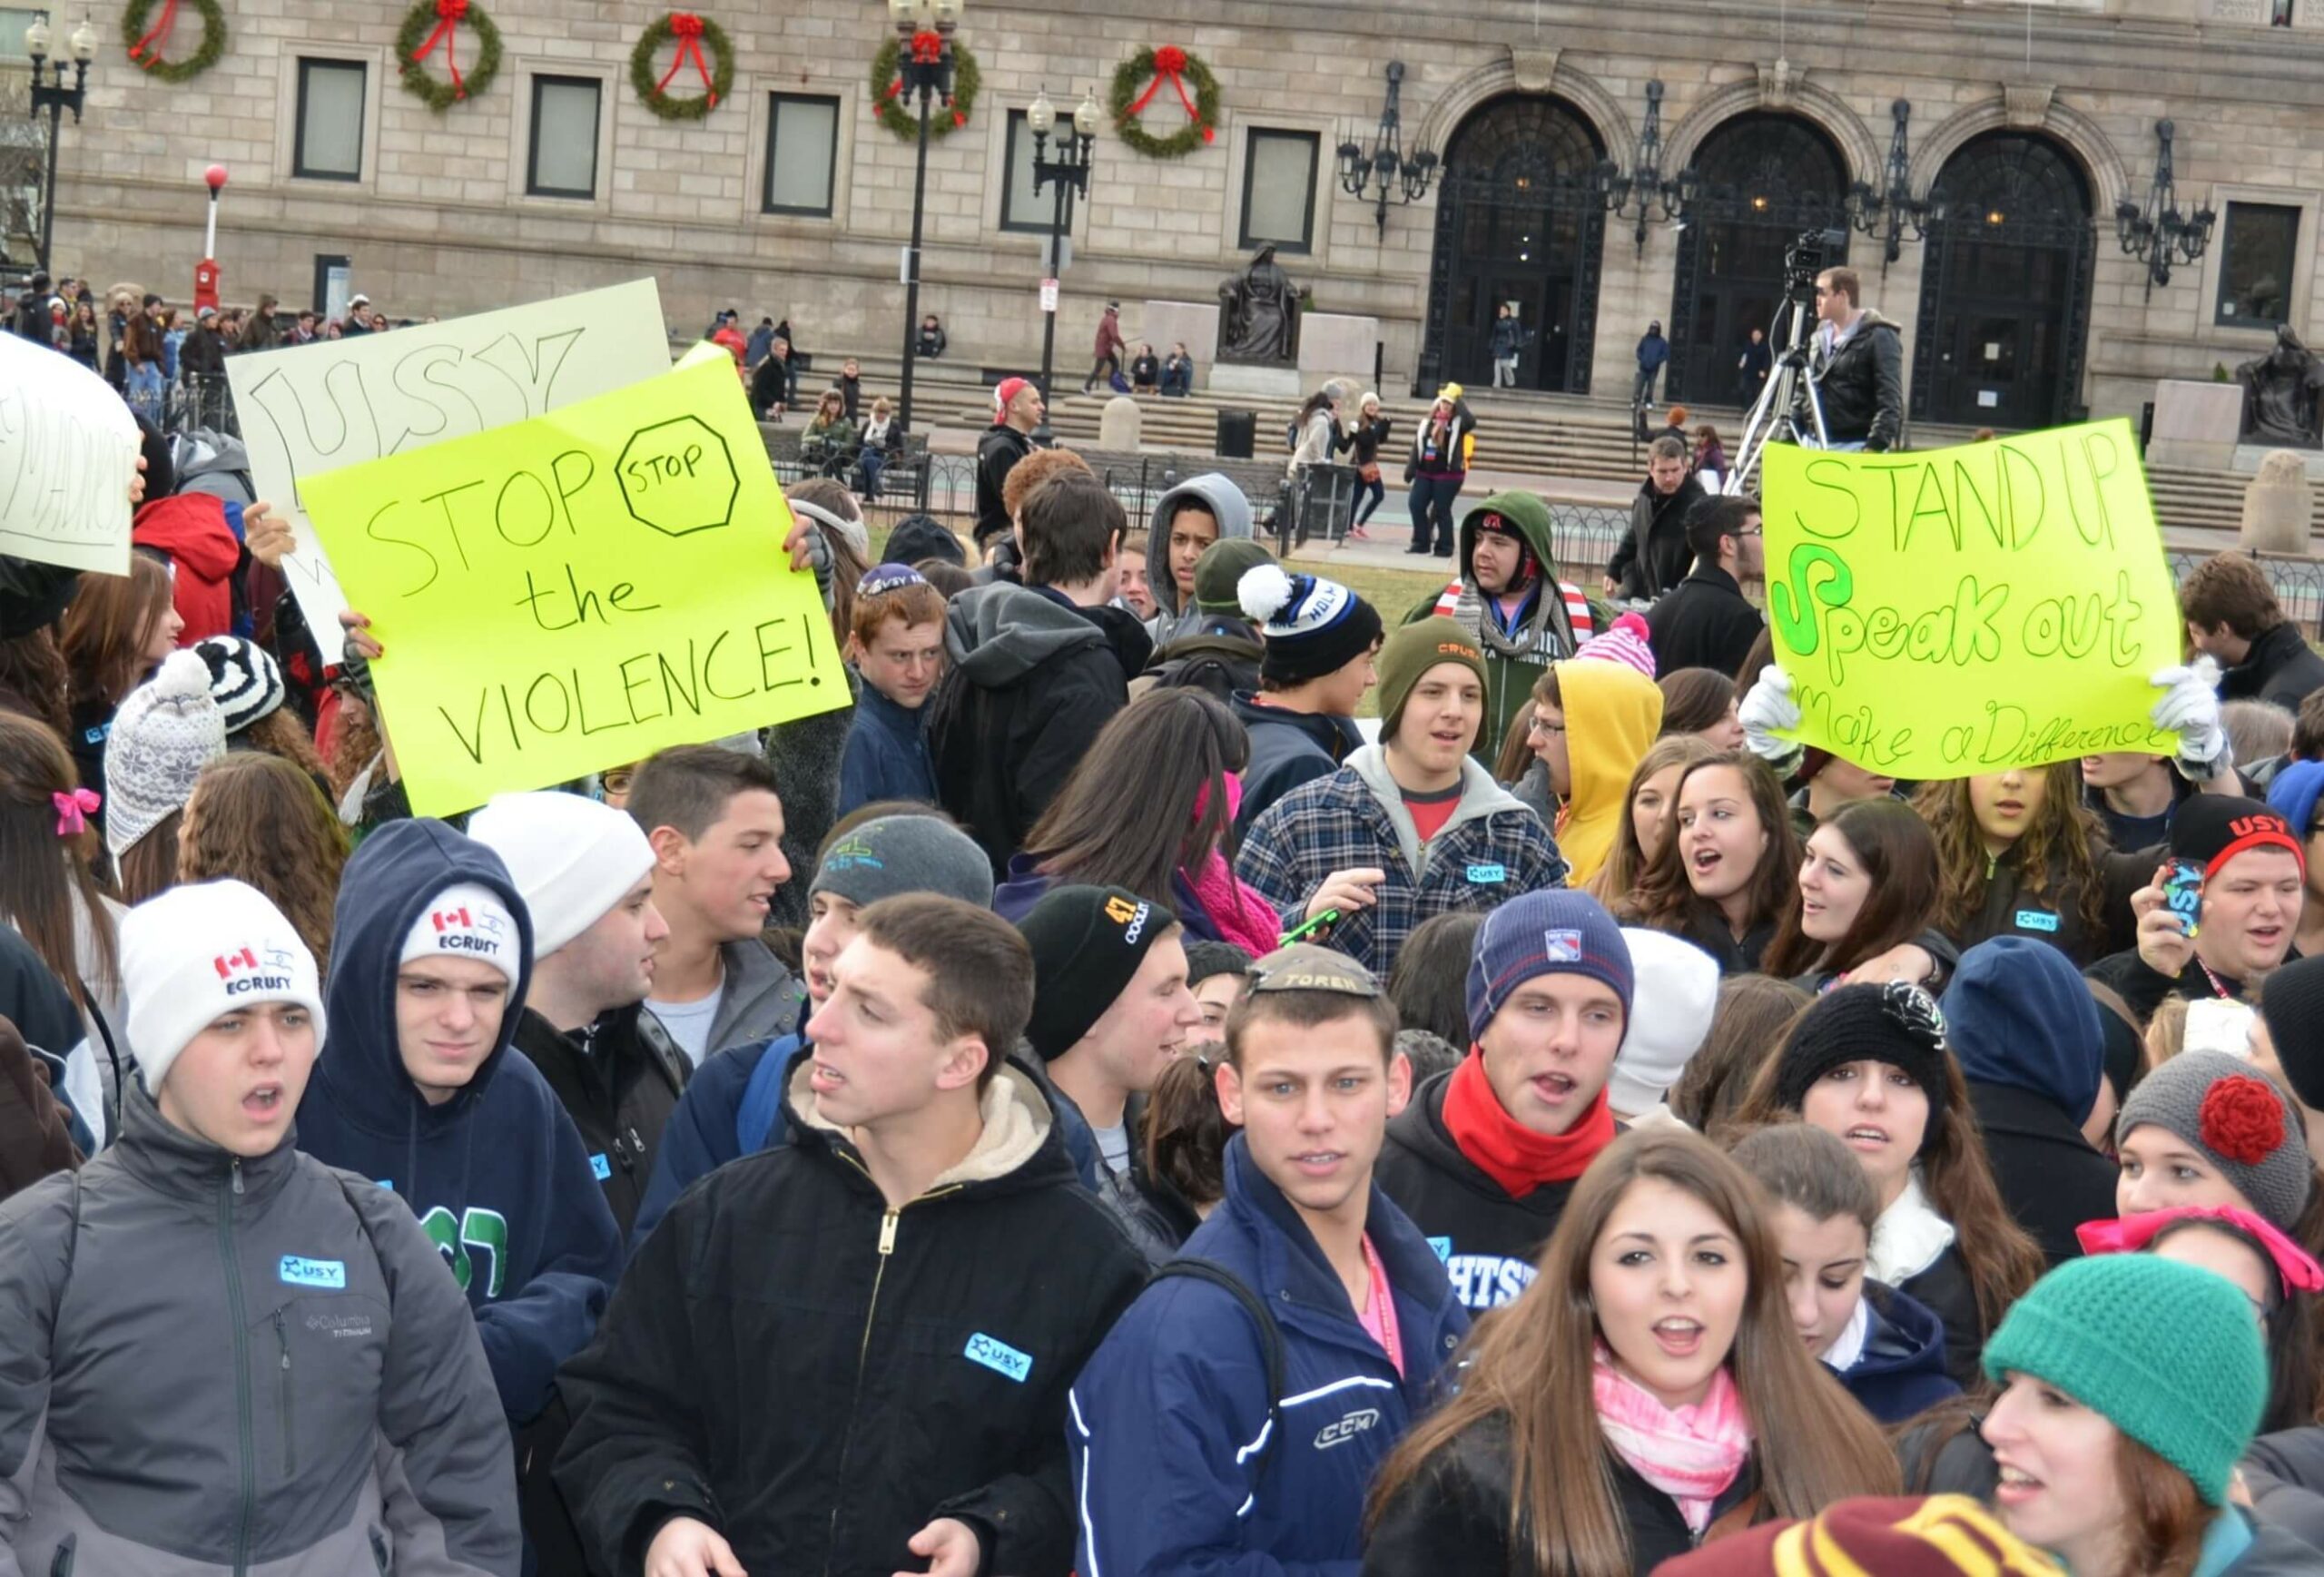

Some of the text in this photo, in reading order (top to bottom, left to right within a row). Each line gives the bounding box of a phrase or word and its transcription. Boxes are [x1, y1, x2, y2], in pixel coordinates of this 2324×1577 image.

[627, 444, 703, 493] STOP
[1796, 432, 2118, 552] STAND UP
[367, 449, 595, 597] STOP
[515, 563, 662, 630] the
[1771, 543, 2142, 687] Speak out
[438, 614, 822, 764] VIOLENCE!
[1941, 725, 1975, 764] a
[1977, 700, 2168, 765] Difference
[2229, 814, 2286, 836] USY
[1105, 896, 1137, 923] 47
[439, 934, 499, 956] ECRUSY
[226, 976, 291, 995] ECRUSY
[302, 1265, 339, 1278] USY
[1447, 1255, 1541, 1307] HTS
[990, 1347, 1024, 1369] USY
[1320, 1414, 1372, 1443] CCM
